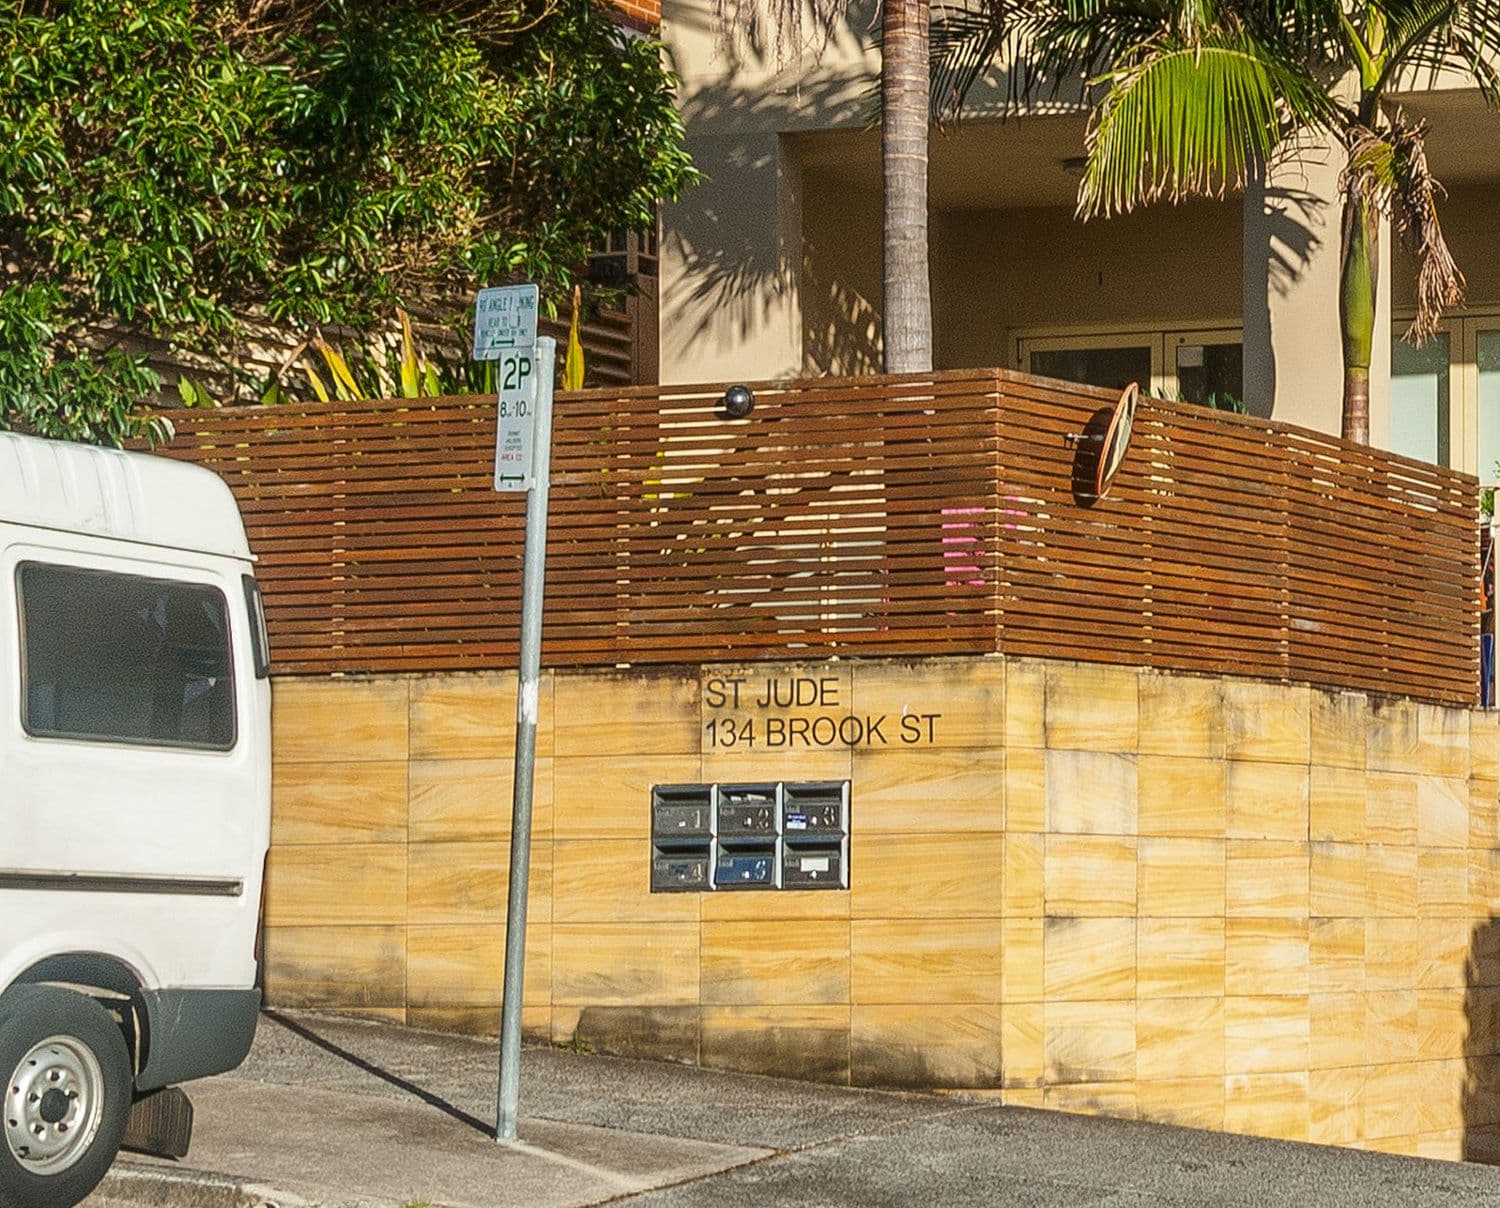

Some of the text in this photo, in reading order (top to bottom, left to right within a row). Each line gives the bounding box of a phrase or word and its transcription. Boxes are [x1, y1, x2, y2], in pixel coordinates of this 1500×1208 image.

[503, 357, 532, 390] 2P
[706, 677, 840, 709] ST JUDE
[705, 713, 942, 748] 134 BROOK ST
